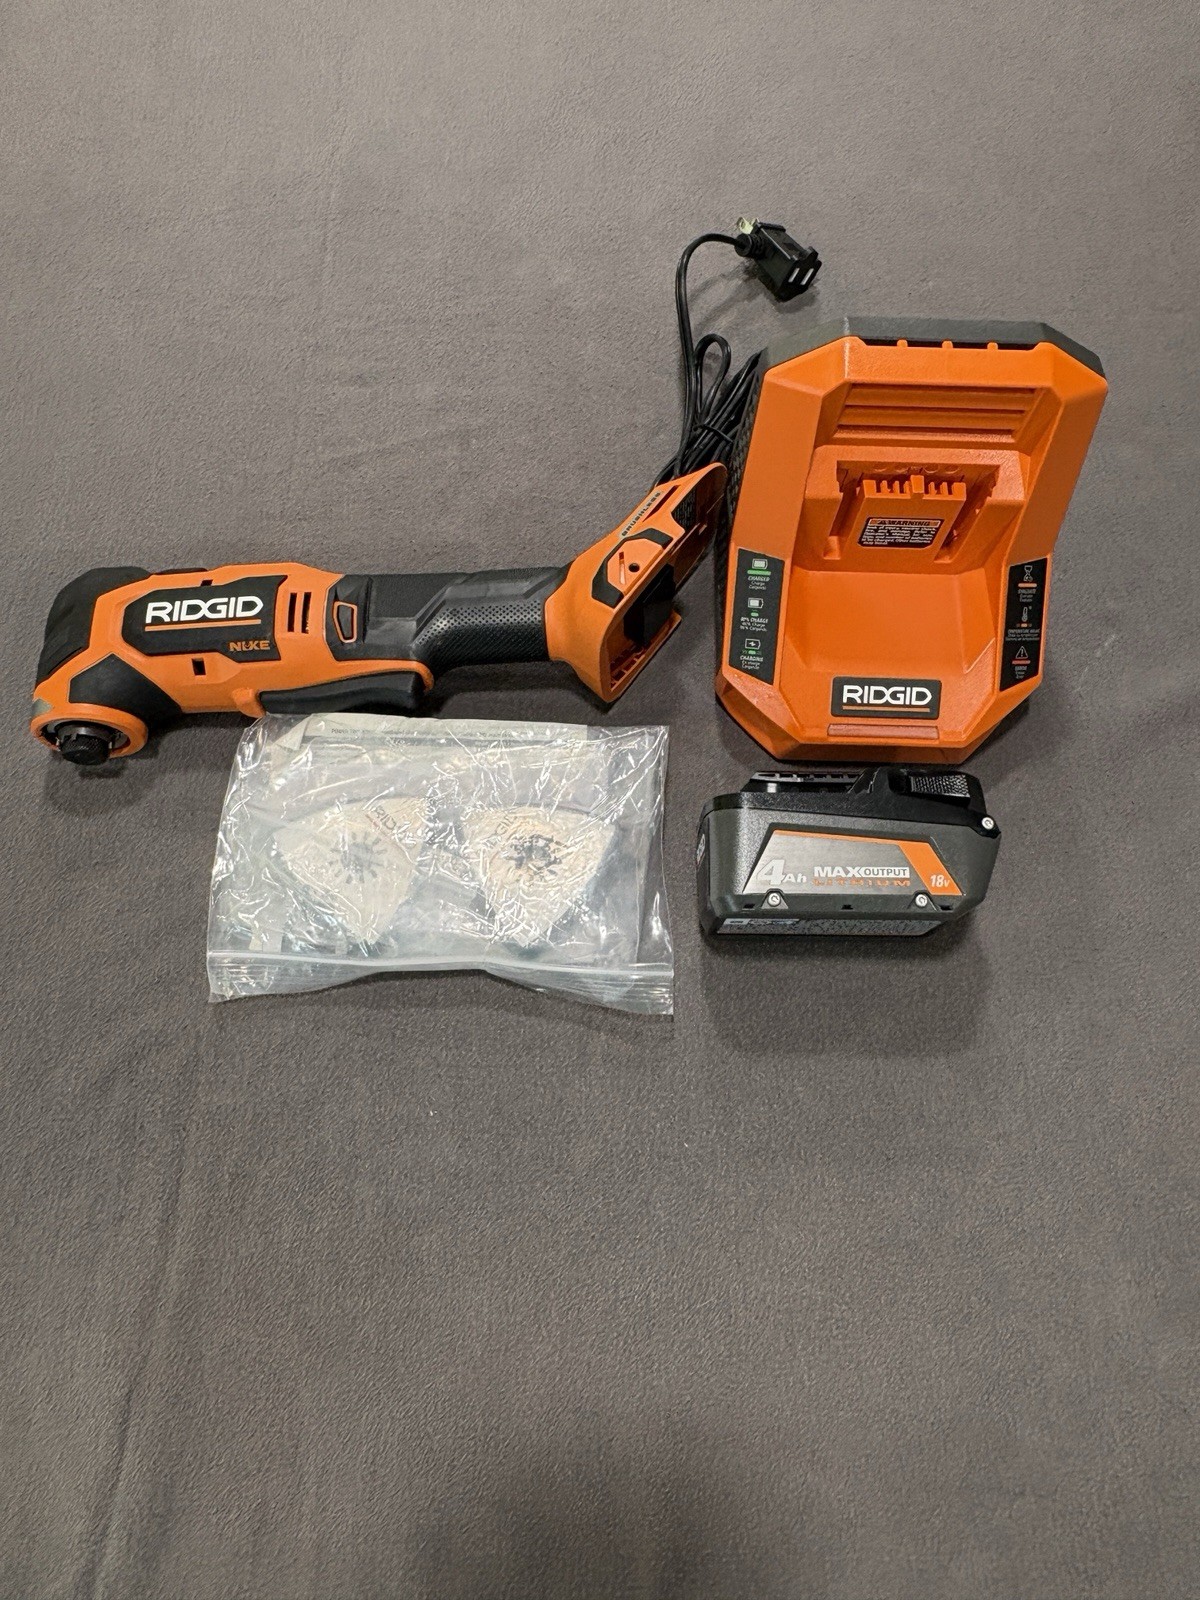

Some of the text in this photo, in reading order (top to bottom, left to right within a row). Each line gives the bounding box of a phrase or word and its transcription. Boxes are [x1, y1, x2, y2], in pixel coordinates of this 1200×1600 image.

[145, 596, 264, 624] RIDGID
[229, 640, 271, 652] NUKE
[842, 684, 933, 706] RIDGID
